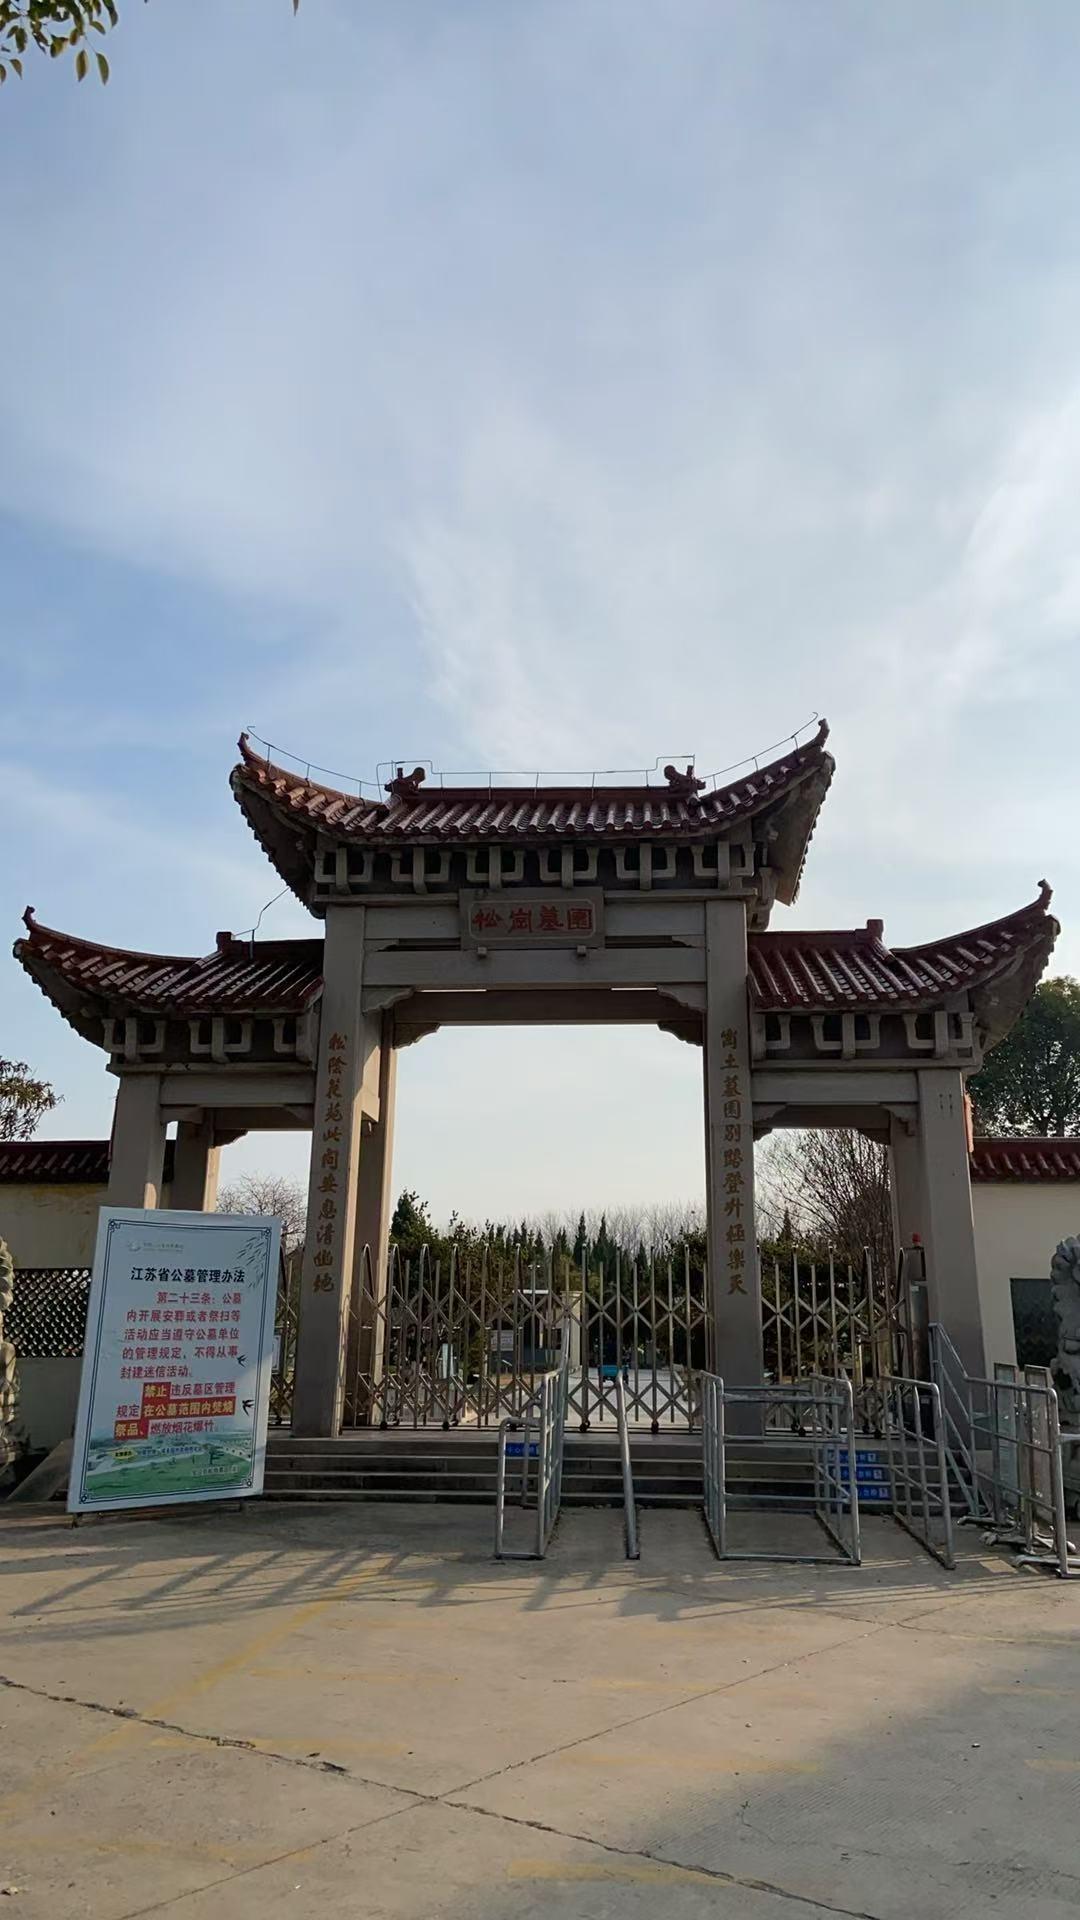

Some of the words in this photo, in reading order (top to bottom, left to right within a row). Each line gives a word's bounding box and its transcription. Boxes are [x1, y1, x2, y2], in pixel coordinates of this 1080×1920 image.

[131, 1267, 245, 1283] 江苏省公墓管理办法
[126, 1309, 240, 1323] 内开展安葬或者祭扫等
[124, 1328, 239, 1341] 活动应当遵守公墓单位
